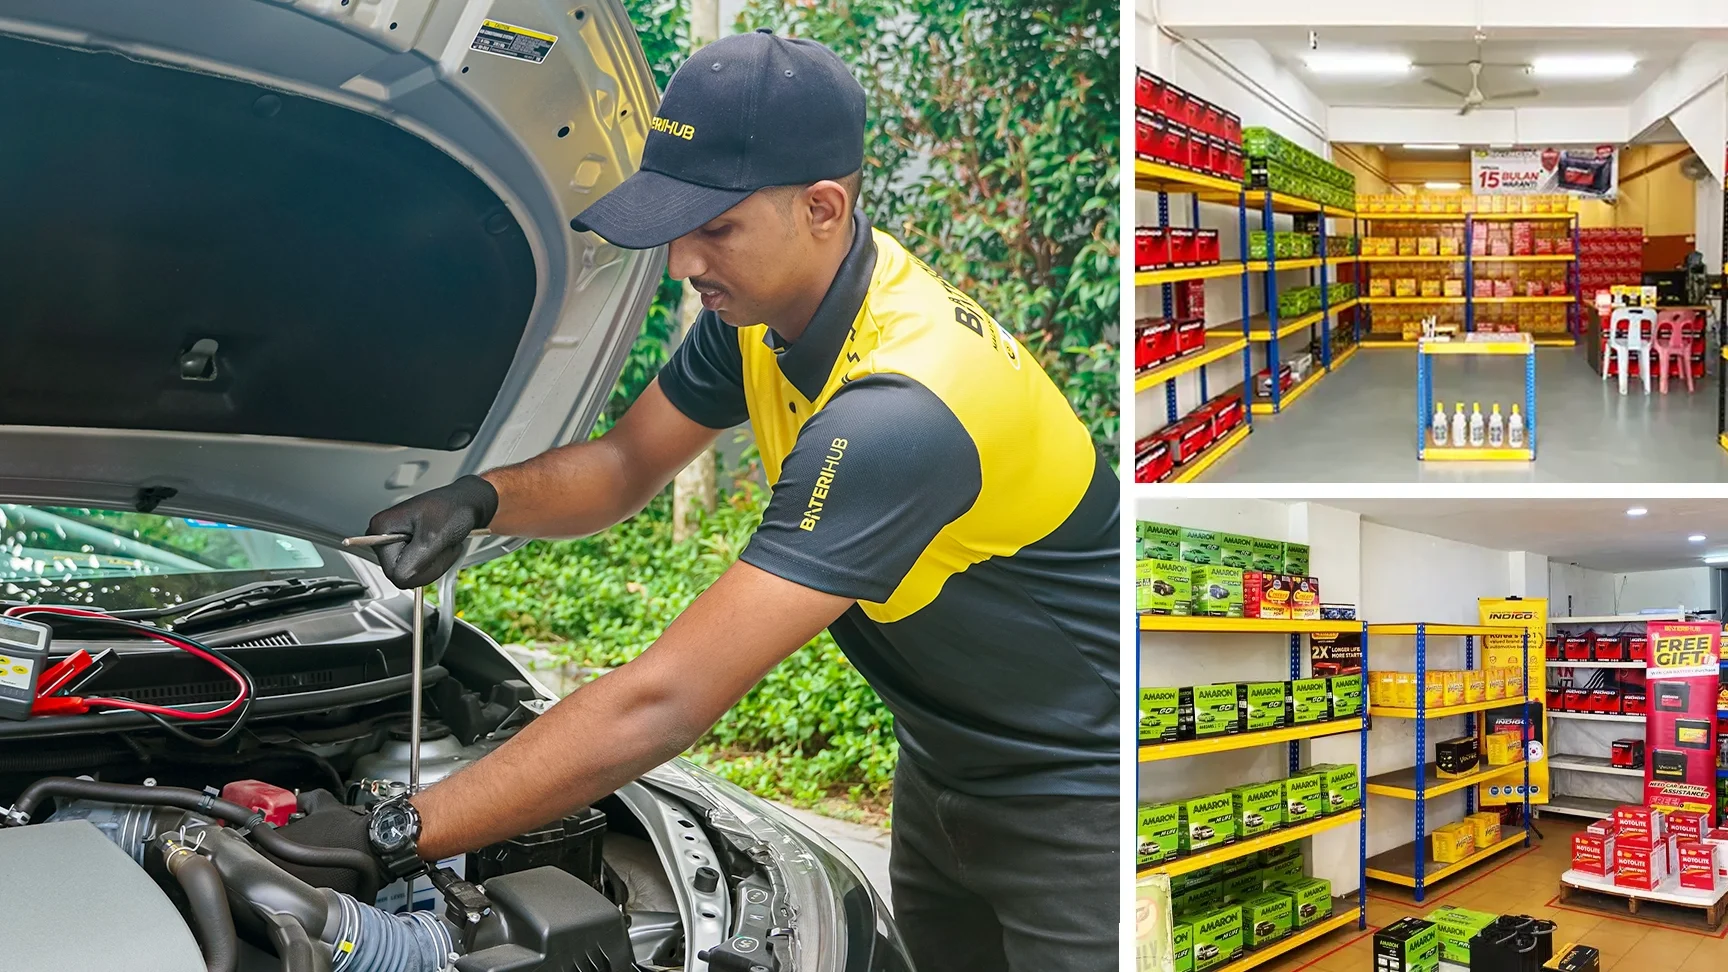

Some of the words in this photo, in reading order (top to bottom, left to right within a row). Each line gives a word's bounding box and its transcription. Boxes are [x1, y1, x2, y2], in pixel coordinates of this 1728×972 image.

[1479, 171, 1500, 188] 15
[1502, 172, 1539, 180] BULAN
[800, 438, 848, 531] BATERIHUB
[1146, 526, 1179, 536] AMARON
[1187, 531, 1215, 540] AMARON
[1224, 537, 1250, 546] AMARON
[1254, 541, 1279, 550] AMARON
[1288, 545, 1308, 554] AMARON
[1156, 562, 1187, 572] AMARON
[1211, 568, 1239, 577] AMARON
[1656, 637, 1709, 652] FREE
[1657, 651, 1704, 665] GIFT
[1296, 683, 1323, 692] AMARON
[1335, 678, 1359, 688] AMARON
[1143, 692, 1176, 701] AMARON
[1199, 689, 1233, 699] AMARON
[1251, 687, 1281, 697] AMARON
[1331, 771, 1355, 784] AMARON
[1291, 780, 1318, 791] AMARON
[1247, 789, 1278, 802] AMARON
[1663, 788, 1709, 797] ASSISTANCE?
[1193, 799, 1229, 814] AMARON
[1143, 813, 1175, 827] AMARON
[1577, 845, 1600, 853] MOTOLITE
[1303, 886, 1326, 898] AMARON
[1261, 902, 1287, 916] AMARON
[1200, 912, 1238, 934] AMARON
[1380, 940, 1399, 948] AMARON
[1409, 930, 1435, 952] AMARON
